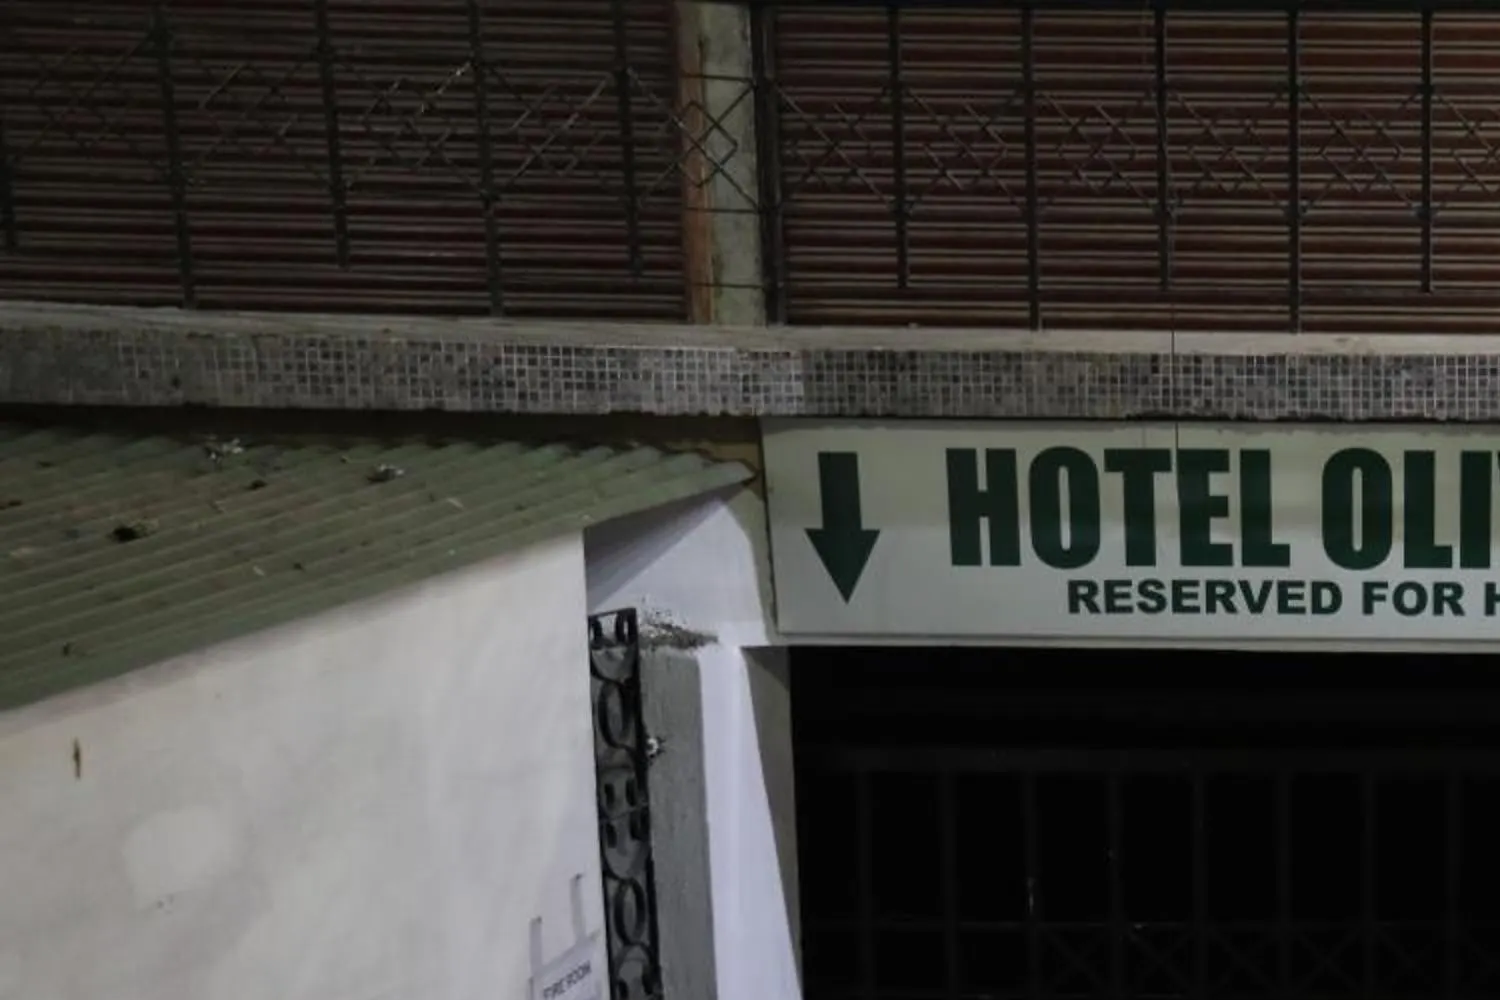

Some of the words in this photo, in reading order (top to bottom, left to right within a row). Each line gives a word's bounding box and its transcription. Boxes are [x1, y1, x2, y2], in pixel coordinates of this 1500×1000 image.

[945, 446, 1291, 570] HOTEL
[1068, 579, 1342, 615] RESERVED
[1363, 582, 1464, 617] FOR
